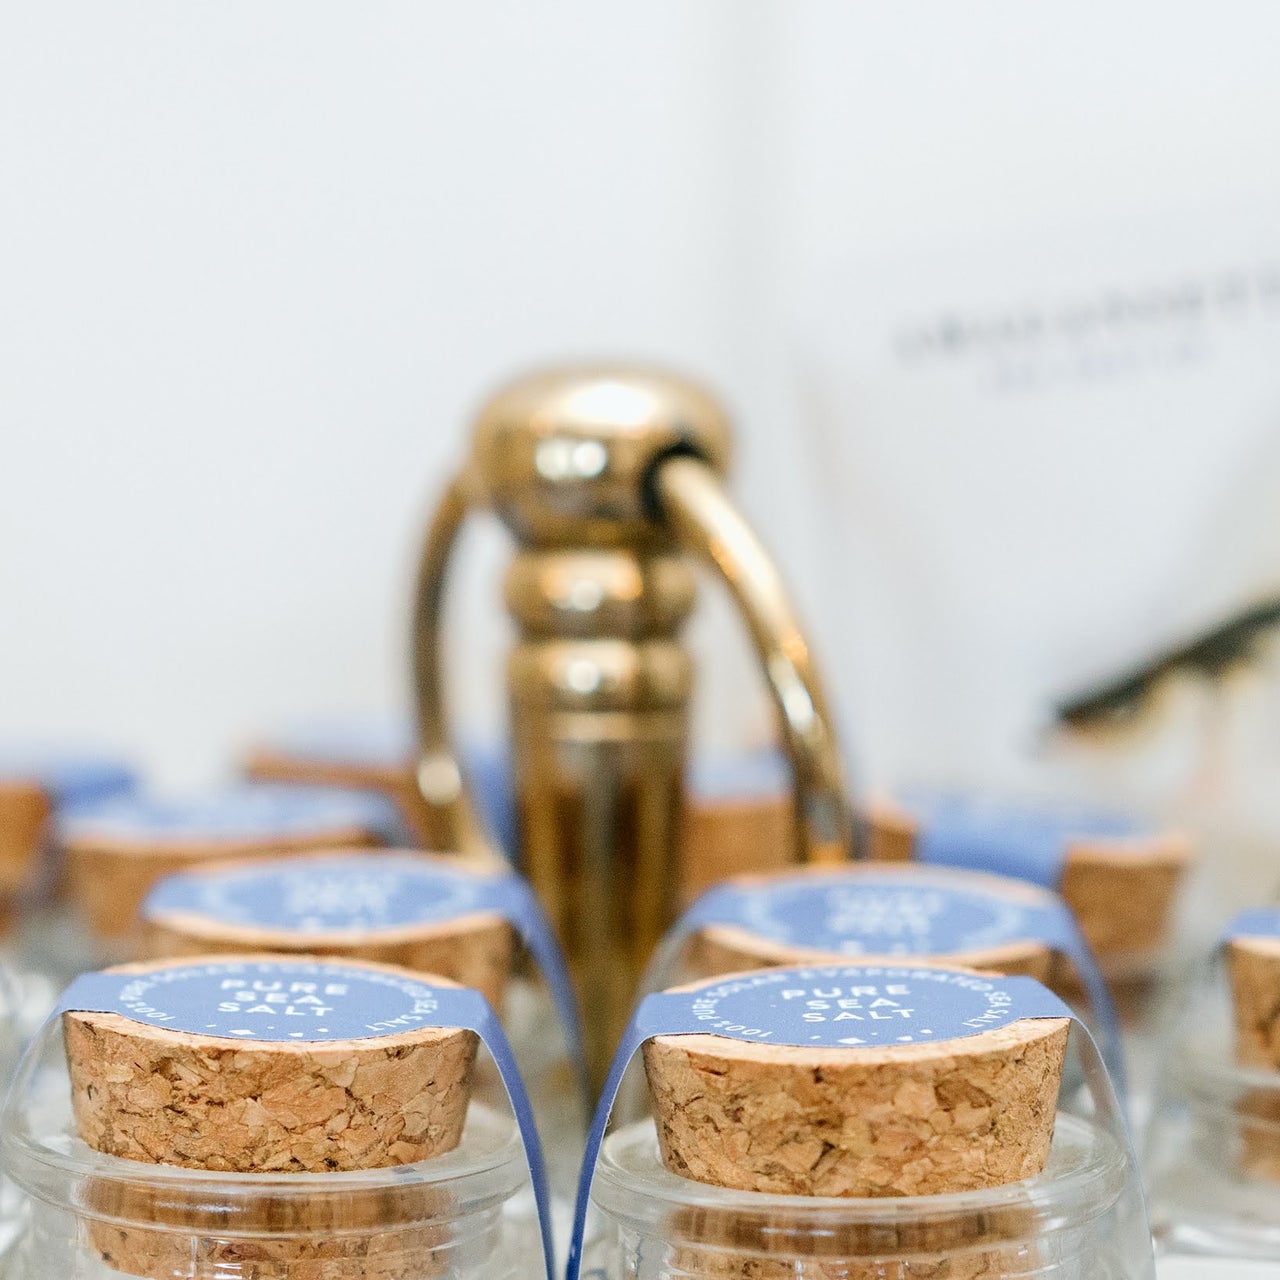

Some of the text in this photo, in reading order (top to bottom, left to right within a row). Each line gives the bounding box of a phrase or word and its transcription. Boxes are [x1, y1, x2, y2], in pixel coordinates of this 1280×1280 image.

[220, 978, 350, 997] PURE
[781, 983, 912, 1001] PURE
[234, 990, 324, 1007] SEA
[805, 997, 901, 1011] SEA
[216, 1001, 335, 1017] SALT
[802, 1008, 915, 1023] SALT
[961, 1008, 1010, 1028] SALT
